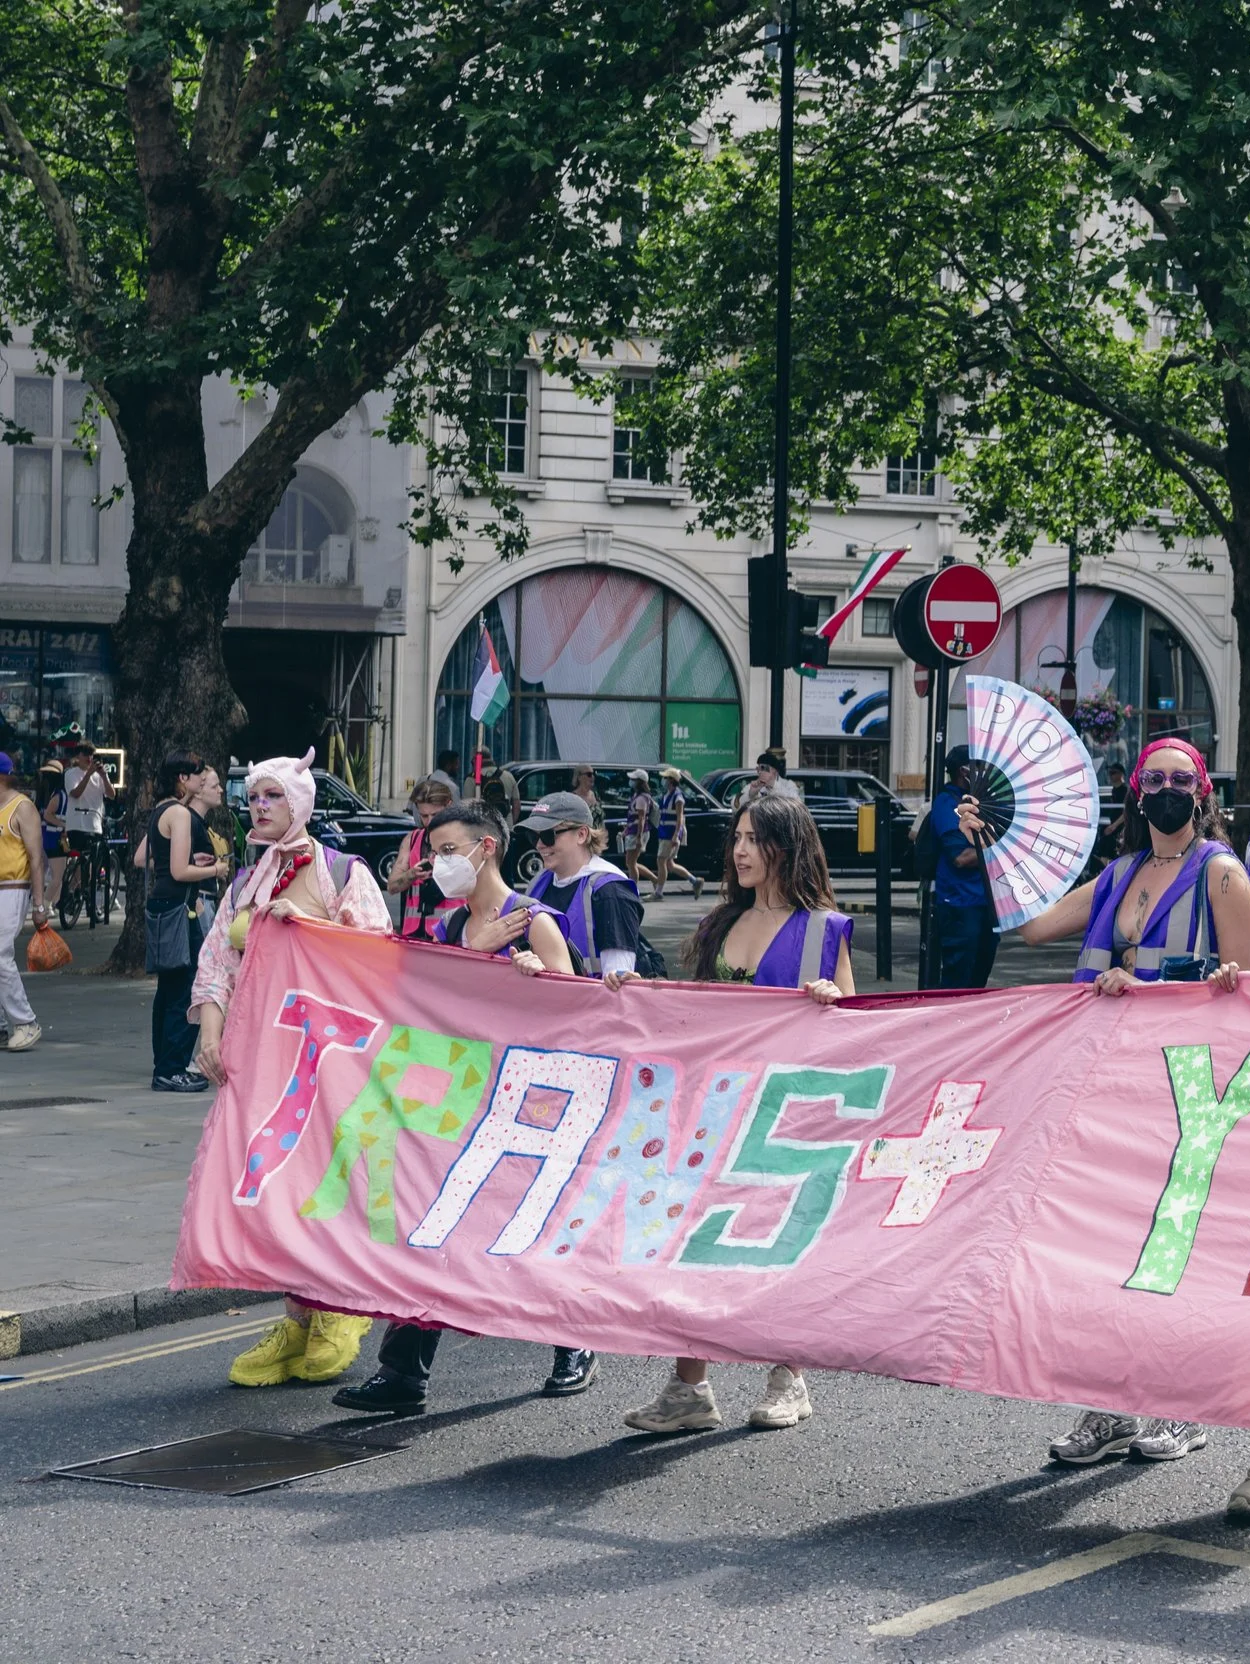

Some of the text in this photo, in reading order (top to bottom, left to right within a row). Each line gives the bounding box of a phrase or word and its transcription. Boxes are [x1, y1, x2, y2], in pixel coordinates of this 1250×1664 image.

[50, 632, 99, 652] 24/7
[935, 732, 943, 743] 5
[980, 690, 1089, 906] POWER
[233, 989, 1004, 1271] TRANS+
